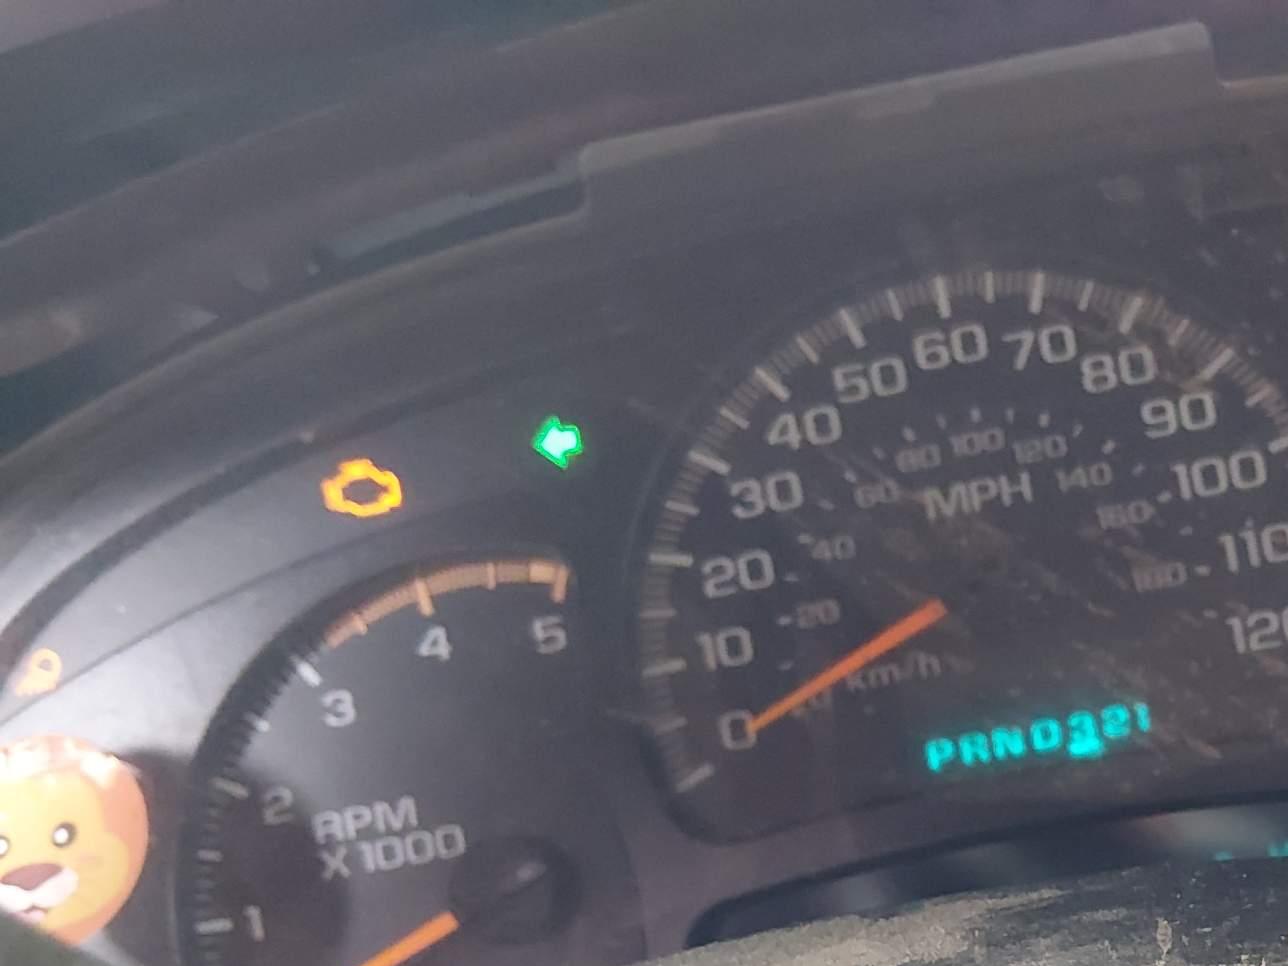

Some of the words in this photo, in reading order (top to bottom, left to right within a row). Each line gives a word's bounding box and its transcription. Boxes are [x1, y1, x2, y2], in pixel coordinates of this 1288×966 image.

[912, 324, 988, 369] 60
[1003, 325, 1078, 369] 70
[832, 352, 907, 402] 50
[1081, 349, 1156, 393] 80
[767, 405, 842, 449] 40
[1140, 393, 1218, 439] 90
[950, 427, 1005, 456] 100
[729, 471, 803, 518] 30
[923, 469, 1033, 520] MPH
[1055, 462, 1113, 493] 140
[1170, 450, 1266, 500] 100
[701, 549, 774, 598] 20
[418, 625, 453, 661] 4
[531, 616, 567, 654] 5
[695, 626, 753, 671] 10
[321, 689, 357, 727] 3
[718, 709, 756, 750] 0
[263, 786, 294, 826] 2
[311, 795, 418, 845] RPM
[243, 904, 266, 941] 1
